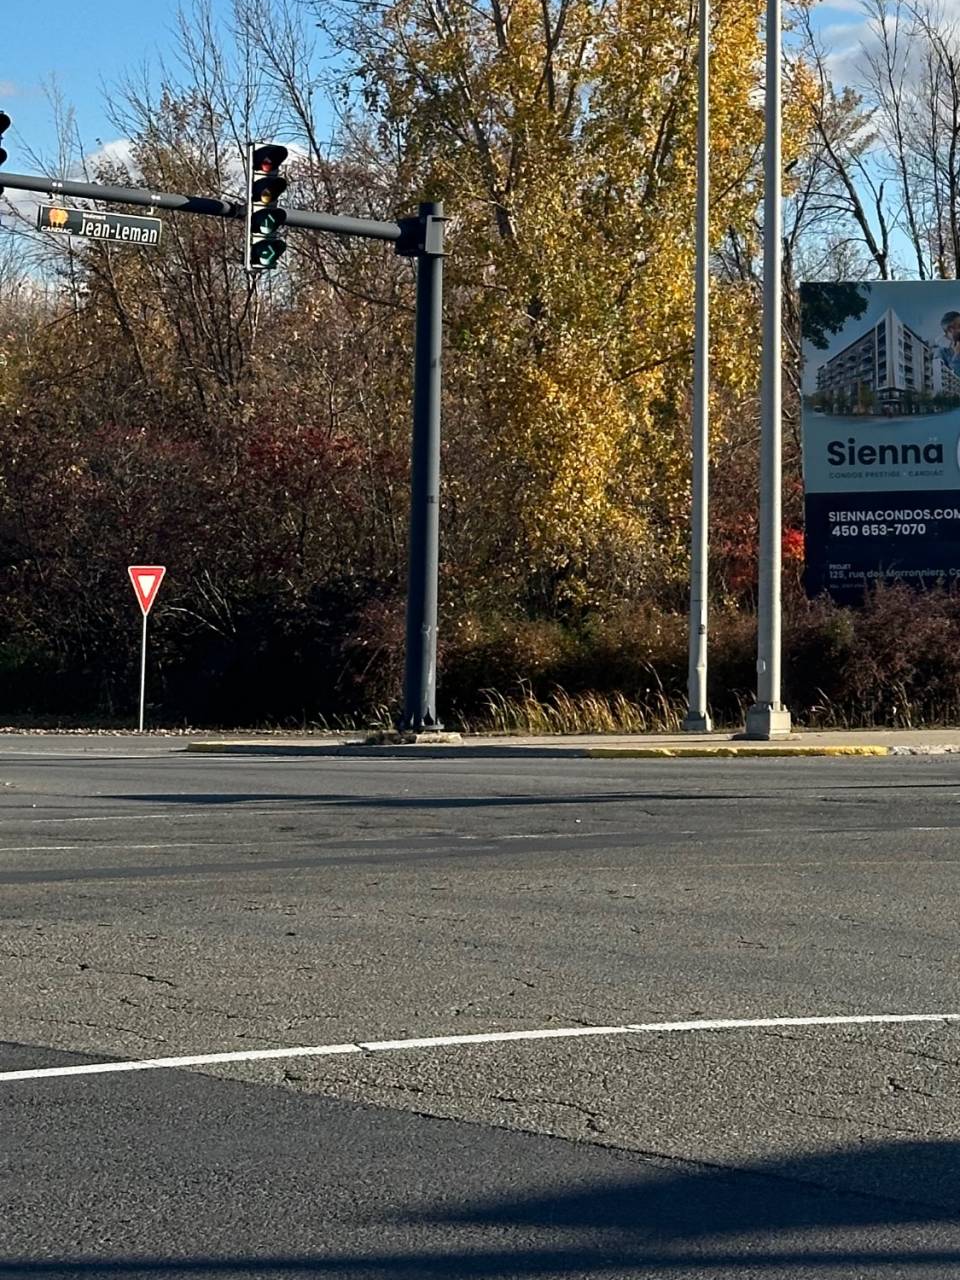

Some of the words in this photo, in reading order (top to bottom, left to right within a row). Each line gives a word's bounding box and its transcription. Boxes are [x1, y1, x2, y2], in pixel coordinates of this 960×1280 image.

[79, 219, 157, 243] Jean-Leman
[827, 437, 943, 466] Sienna
[831, 525, 858, 536] 450
[861, 523, 927, 536] 653-7070
